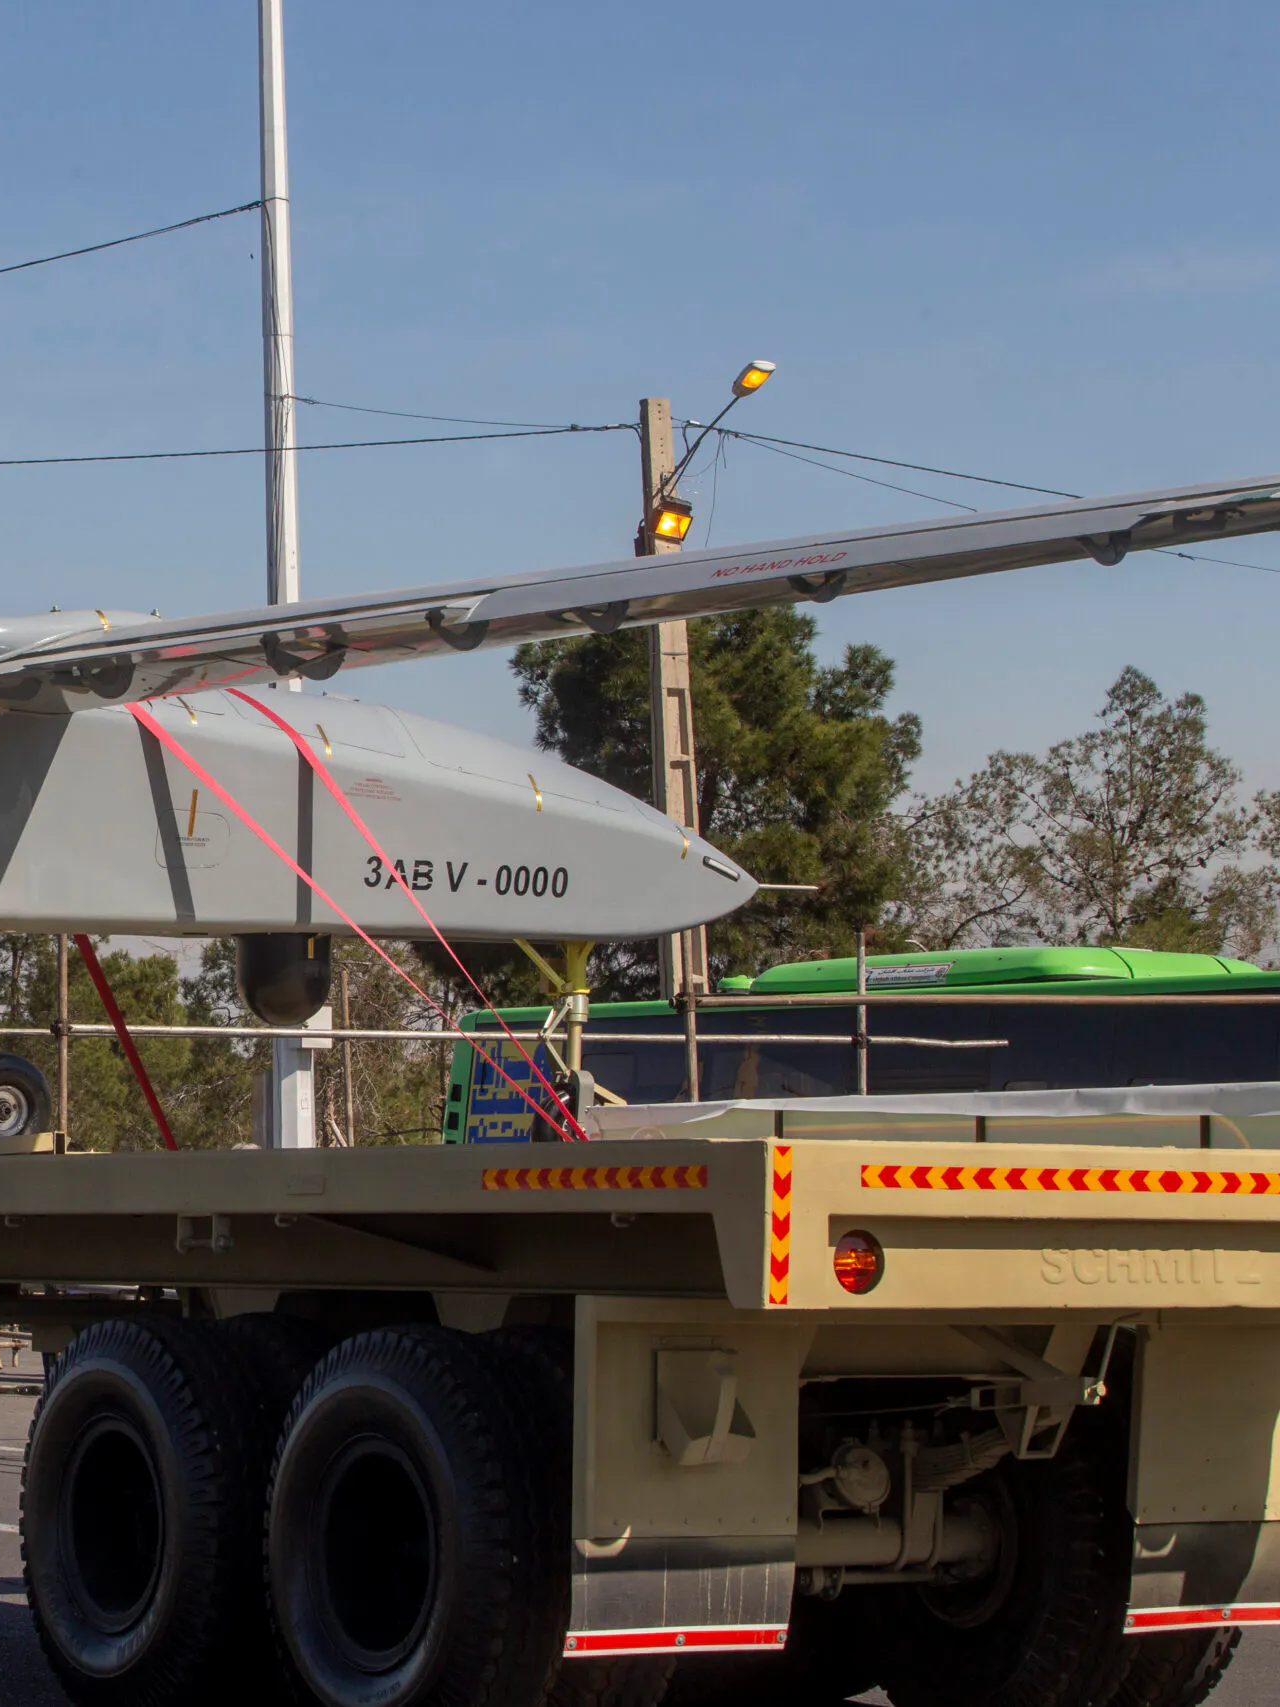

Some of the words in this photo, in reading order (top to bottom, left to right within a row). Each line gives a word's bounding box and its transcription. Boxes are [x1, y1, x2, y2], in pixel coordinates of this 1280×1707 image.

[710, 566, 739, 578] NO
[740, 560, 793, 575] HAND
[793, 552, 847, 567] HOLD
